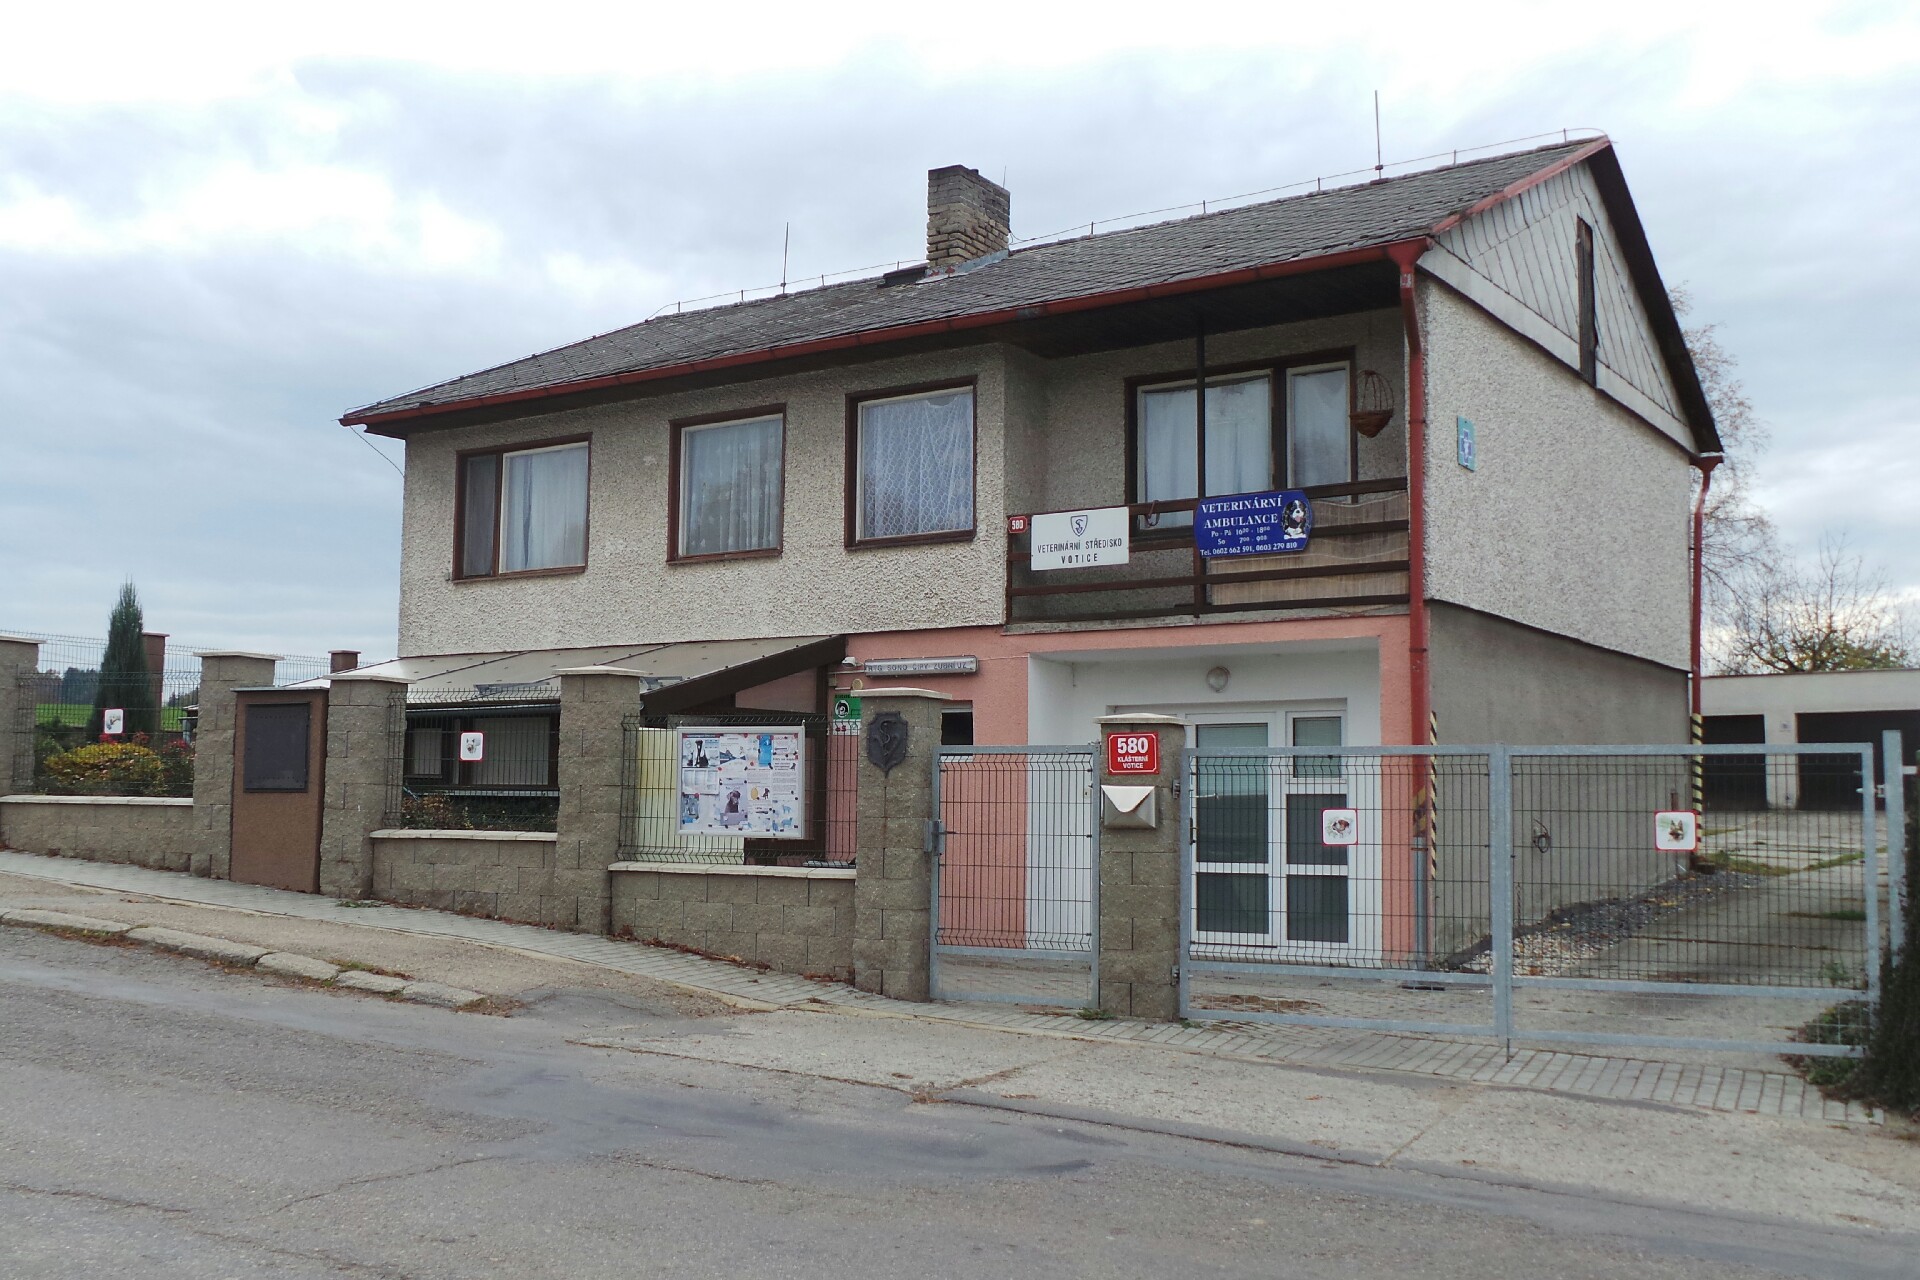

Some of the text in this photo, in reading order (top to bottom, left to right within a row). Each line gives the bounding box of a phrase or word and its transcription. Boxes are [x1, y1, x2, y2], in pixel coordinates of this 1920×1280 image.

[1202, 495, 1283, 513] VETERINÁRNÍ
[1011, 519, 1024, 530] 580
[1204, 513, 1278, 529] AMBULANCE
[1037, 538, 1122, 553] VETERINÁRNÍ STŘEDISKO
[1272, 542, 1285, 550] 279
[1061, 553, 1098, 564] VOTICE
[1117, 737, 1149, 754] 580
